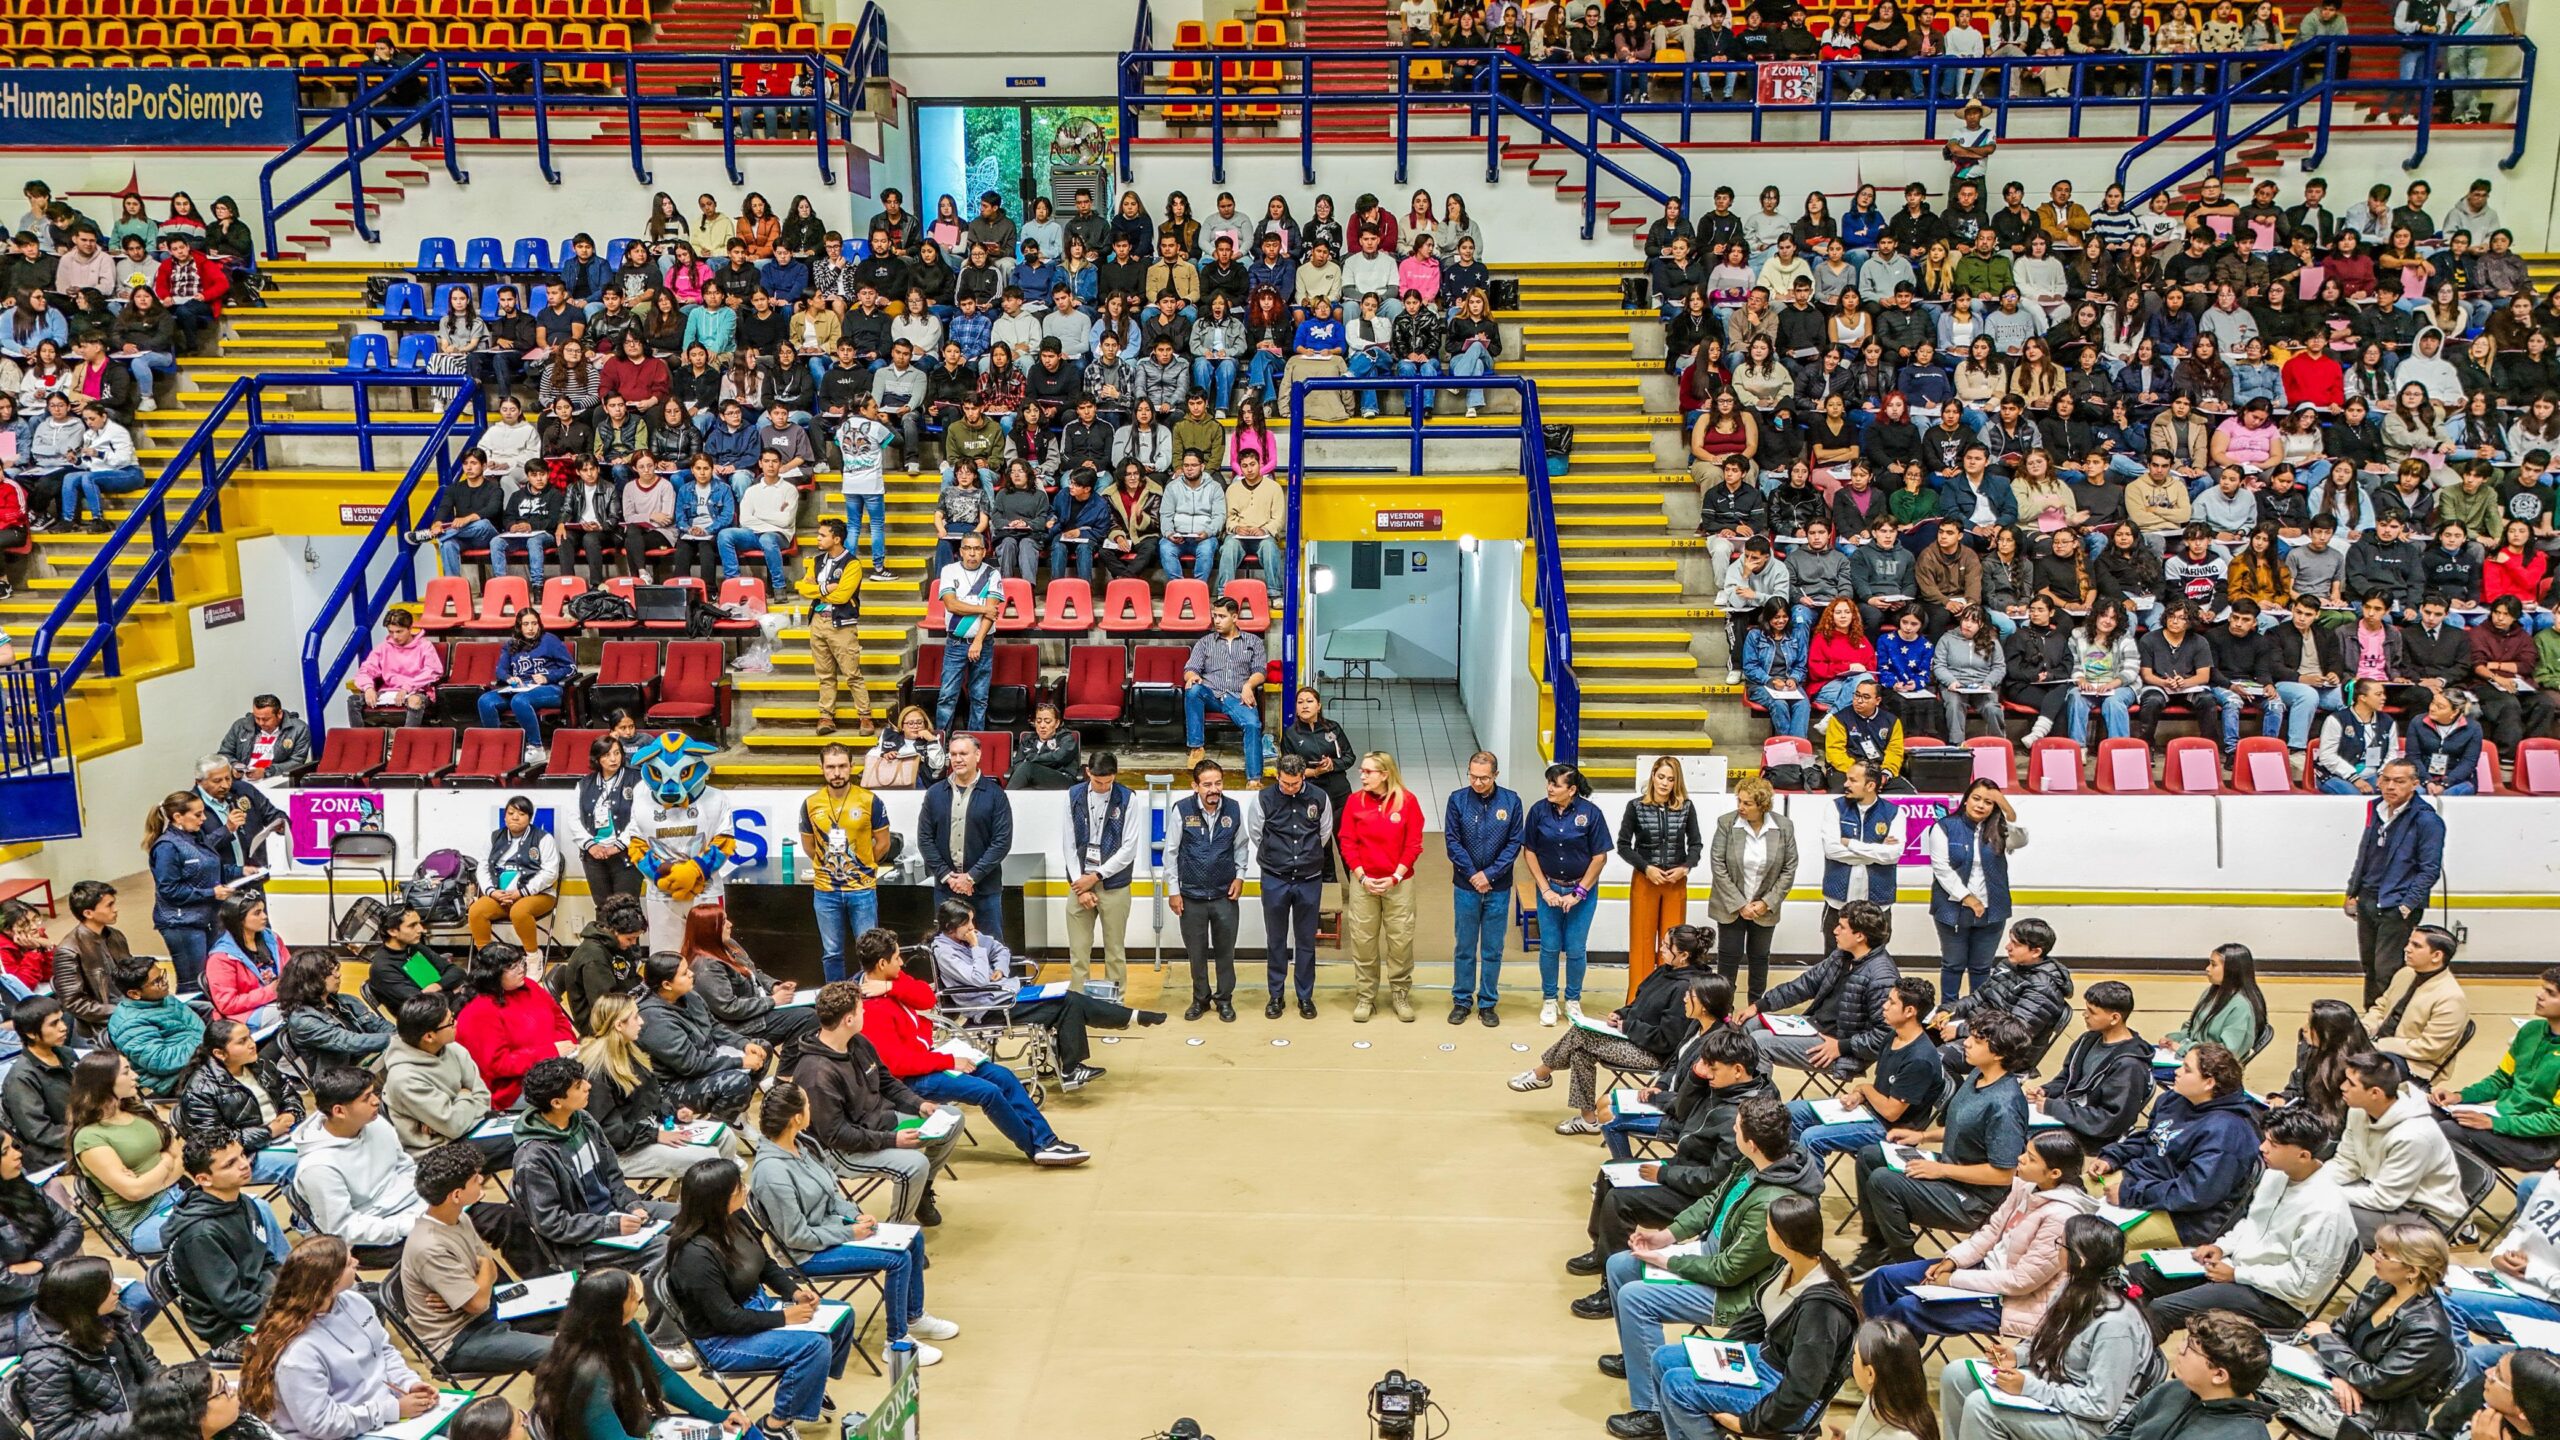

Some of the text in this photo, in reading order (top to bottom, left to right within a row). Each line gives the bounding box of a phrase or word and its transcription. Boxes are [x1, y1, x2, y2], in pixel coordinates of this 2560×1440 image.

[1771, 66, 1804, 77] ZONA
[1014, 79, 1039, 87] SALIDA
[1771, 79, 1802, 100] 13
[0, 82, 264, 128] HumanistaPorSiempre
[2154, 222, 2171, 231] NIKE
[1389, 520, 1424, 528] VISITANTE
[310, 797, 363, 813] ZONA
